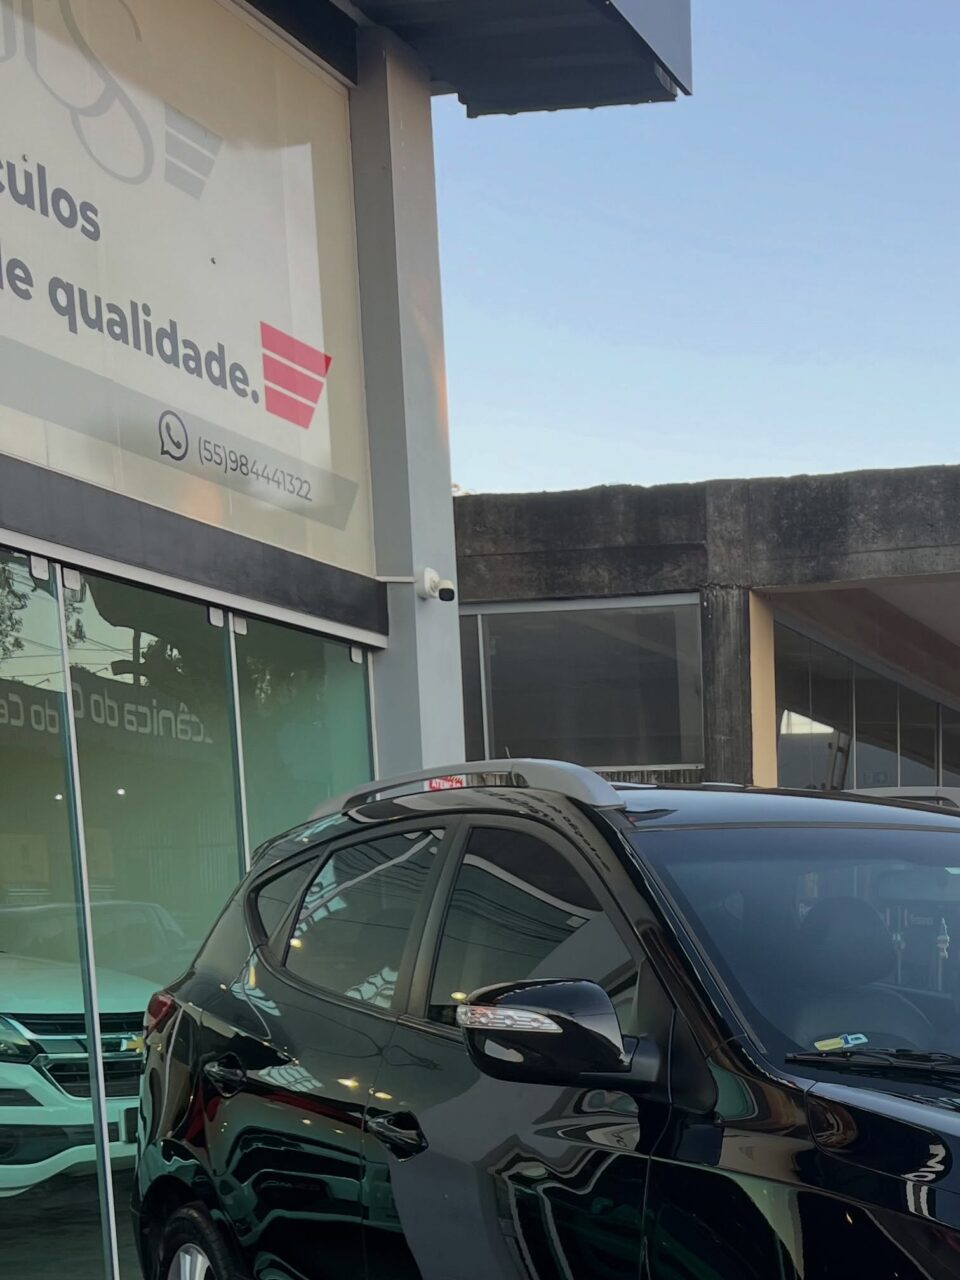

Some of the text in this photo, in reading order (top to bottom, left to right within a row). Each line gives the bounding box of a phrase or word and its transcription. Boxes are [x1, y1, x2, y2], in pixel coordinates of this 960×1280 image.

[0, 241, 259, 404] e qualidade.
[198, 436, 312, 502] (55)984441322
